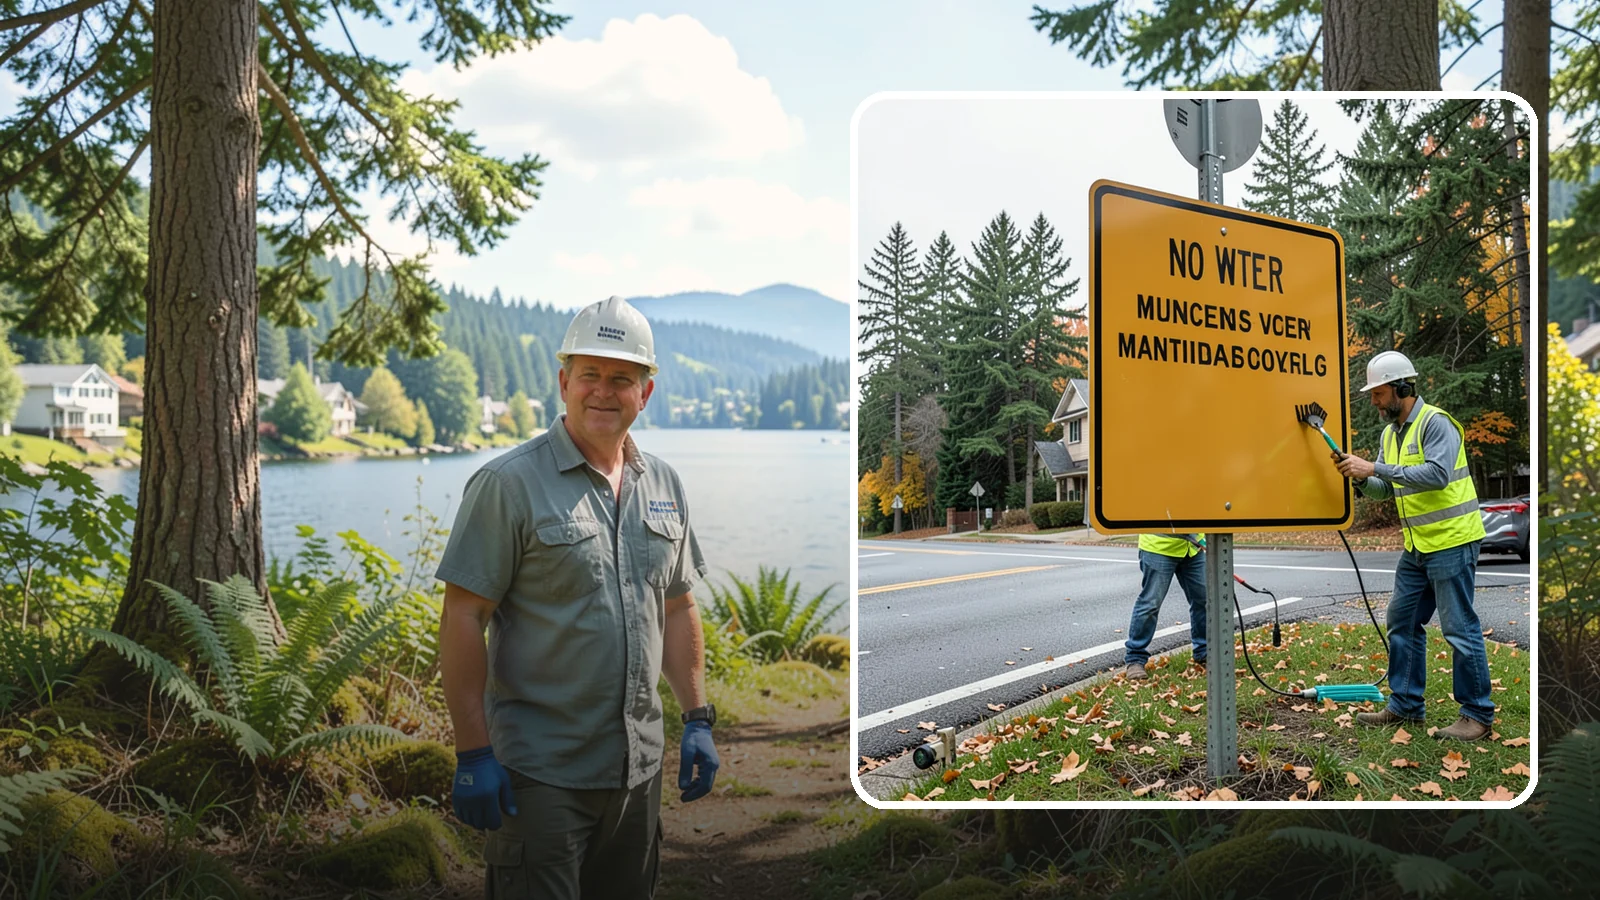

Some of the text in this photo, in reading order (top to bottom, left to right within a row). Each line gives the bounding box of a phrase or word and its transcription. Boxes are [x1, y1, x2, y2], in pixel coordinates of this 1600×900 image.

[1169, 237, 1284, 295] NO WTER
[1137, 293, 1252, 333] MUNCENS
